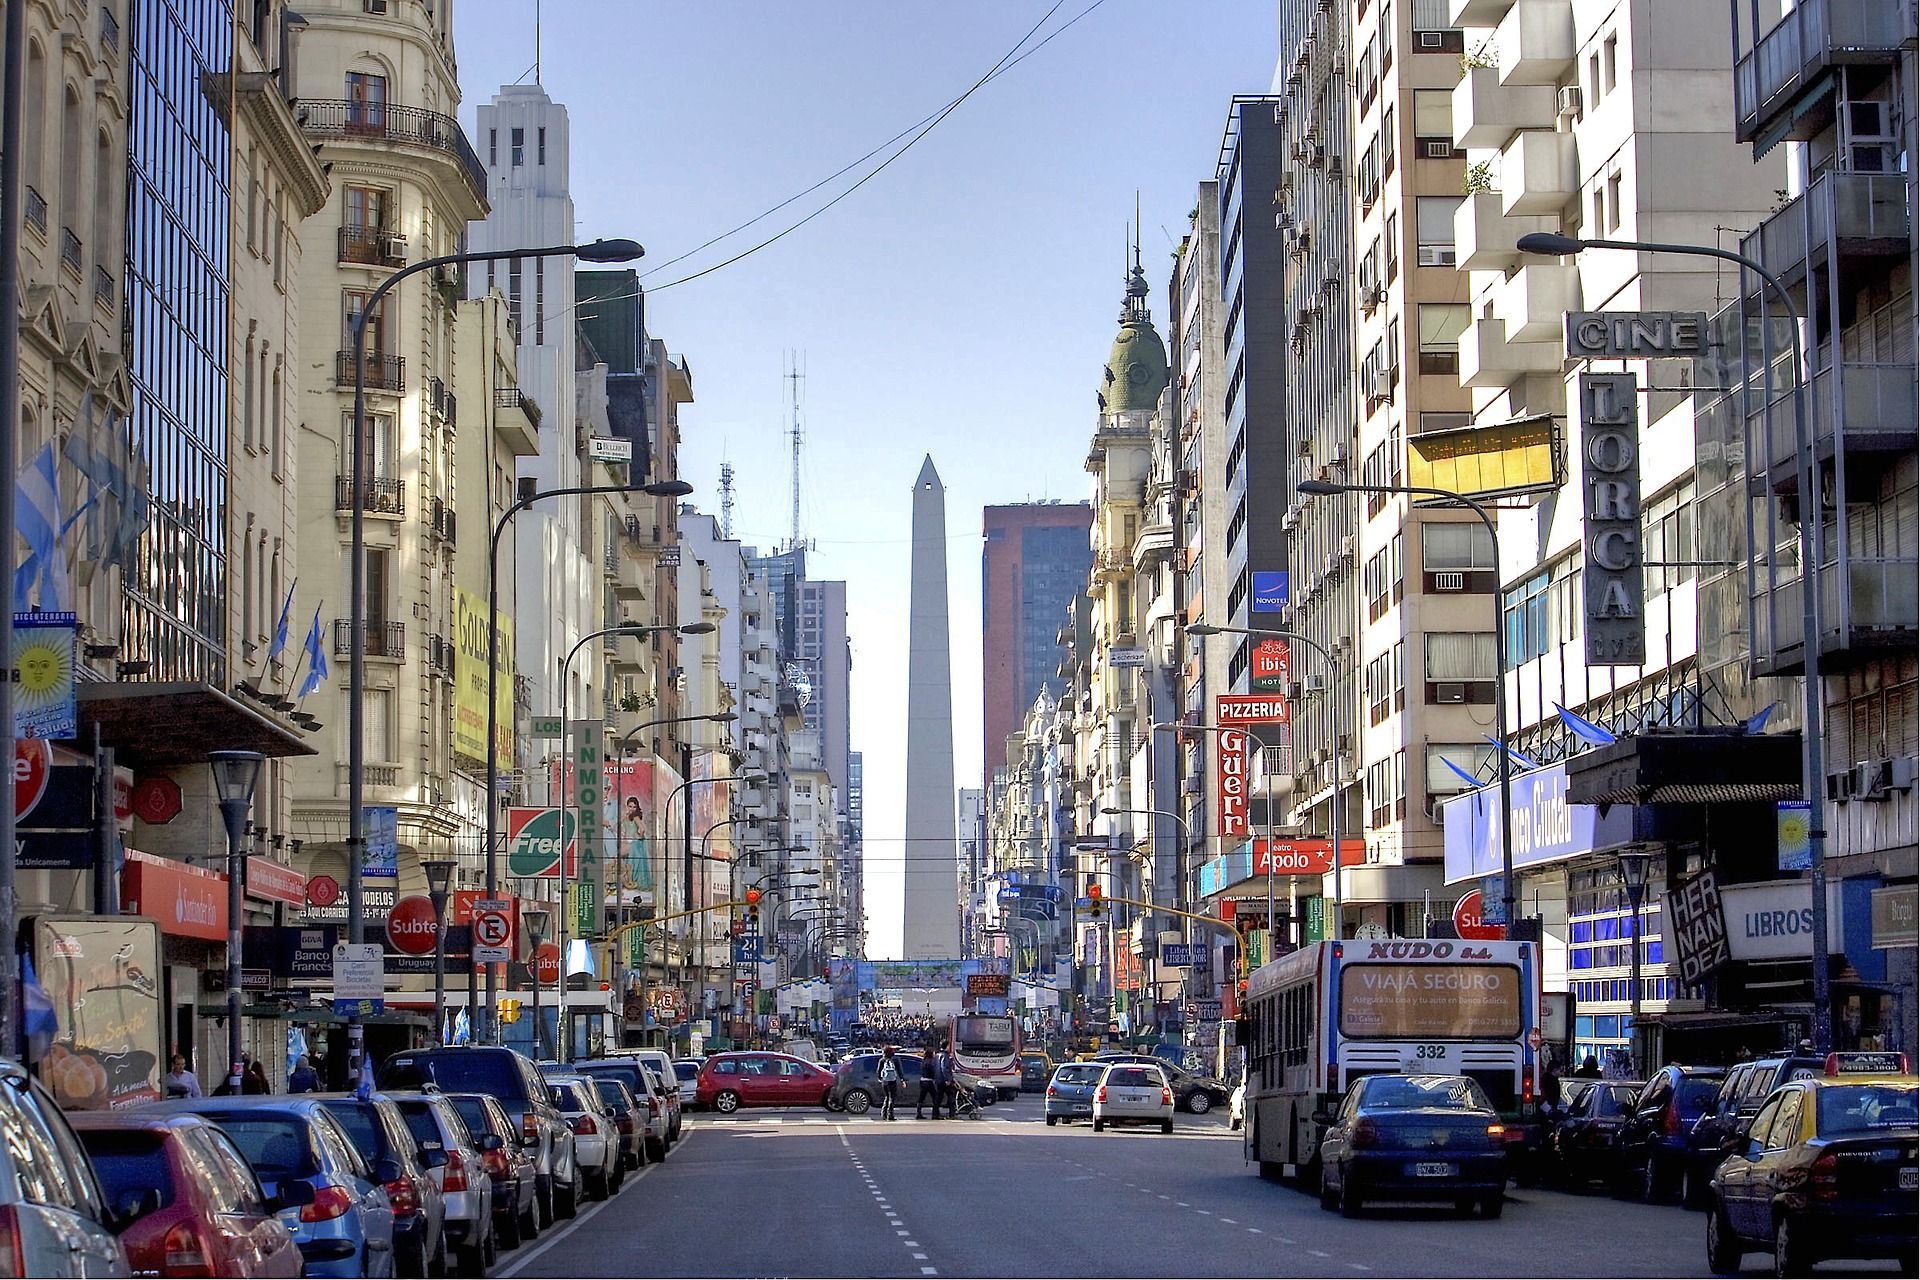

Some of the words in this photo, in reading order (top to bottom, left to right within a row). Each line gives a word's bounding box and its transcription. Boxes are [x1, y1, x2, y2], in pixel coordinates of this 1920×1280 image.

[1577, 318, 1699, 350] CINE
[1588, 381, 1637, 619] LORCA
[14, 612, 75, 621] BICENTENARIO
[458, 593, 510, 676] GOLDSEIN
[1261, 657, 1287, 671] ibis
[1219, 703, 1284, 719] PIZZERIA
[535, 721, 561, 733] LOS
[1220, 730, 1243, 836] Güerr
[579, 727, 596, 884] INMORTAL
[513, 832, 561, 854] Free
[1273, 844, 1292, 852] eatro
[25, 857, 71, 866] Unicamente
[1260, 850, 1309, 872] Apolo
[1671, 871, 1719, 928] HER
[321, 907, 350, 918] CORRIENT
[392, 918, 438, 934] Subte
[486, 919, 500, 939] E
[1745, 908, 1814, 938] LIBROS
[1677, 907, 1723, 959] NAN
[741, 938, 758, 951] 24
[1368, 942, 1455, 959] NUDO
[294, 950, 330, 960] Banco
[398, 958, 436, 968] Uruguay
[1683, 939, 1729, 982] DEZ
[292, 960, 333, 971] Francés
[1362, 969, 1418, 993] VIAJÁ
[1423, 973, 1500, 990] SEGURO
[1416, 1045, 1446, 1059] 332
